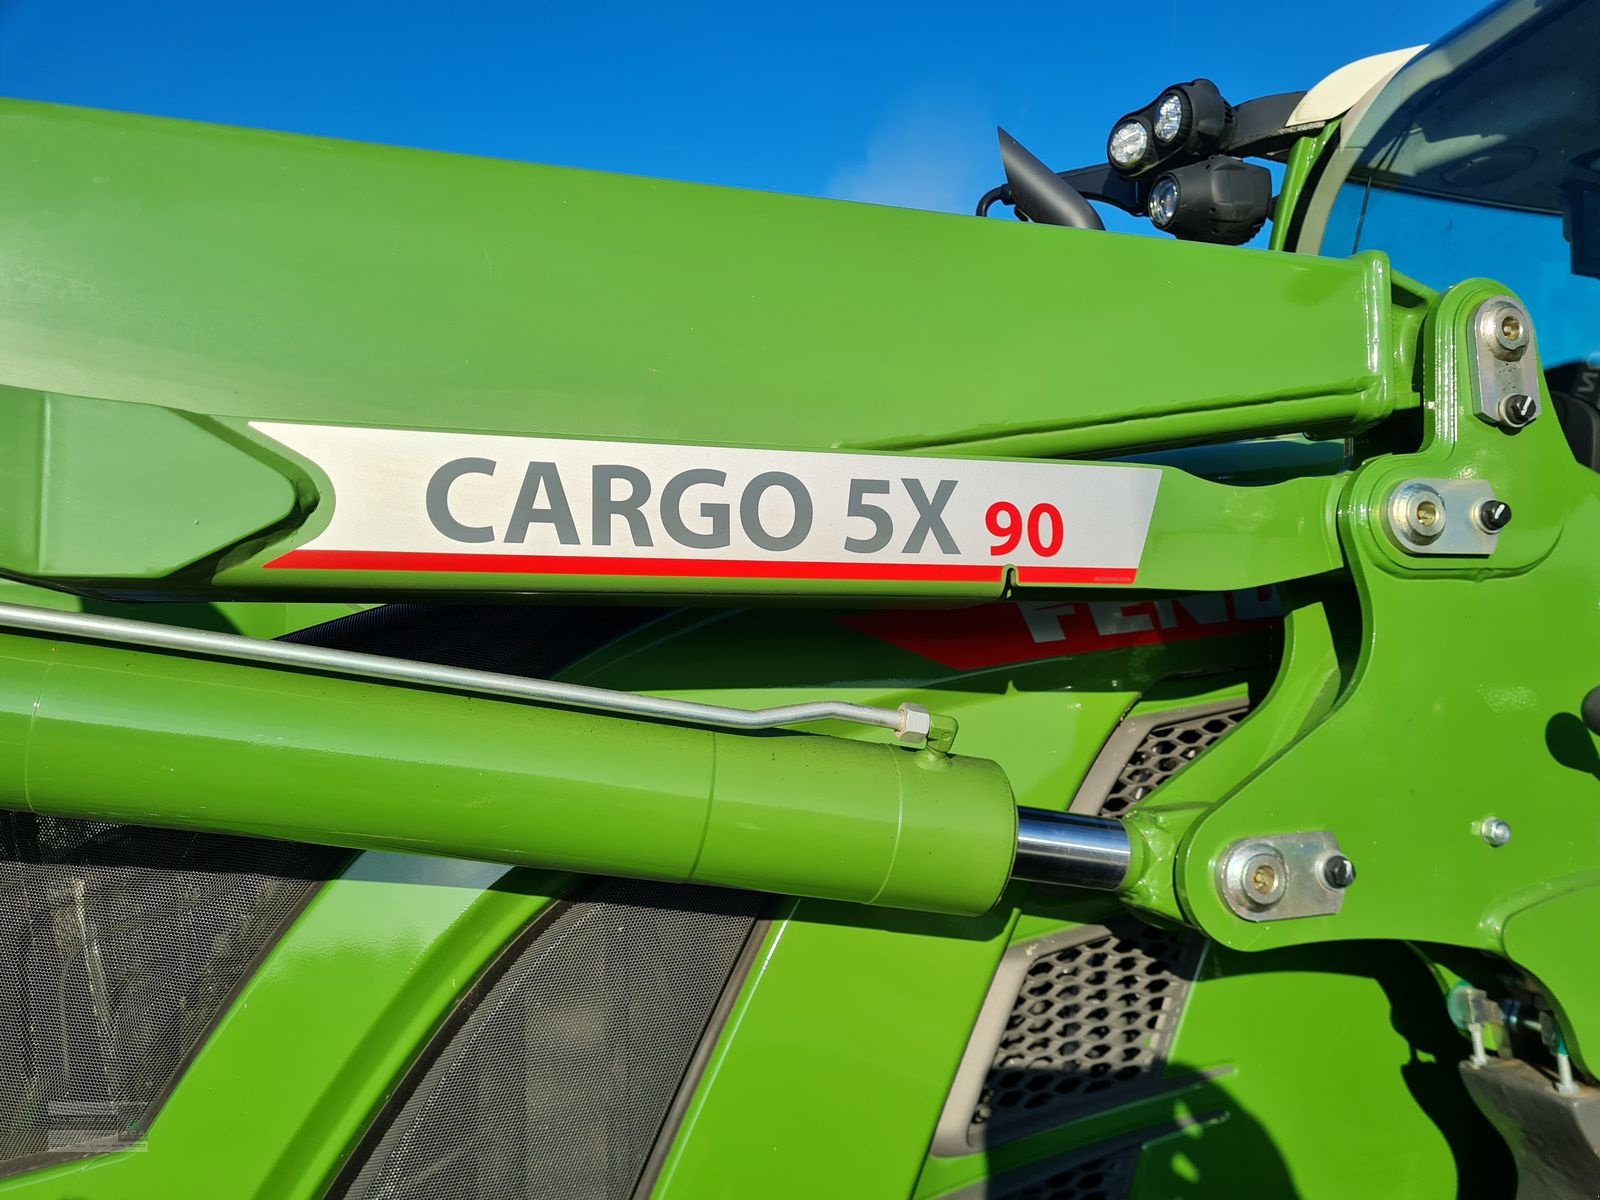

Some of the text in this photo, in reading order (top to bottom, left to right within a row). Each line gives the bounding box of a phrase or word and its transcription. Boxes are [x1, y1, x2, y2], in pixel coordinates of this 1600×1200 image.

[426, 457, 1064, 557] CARGO 5X 90
